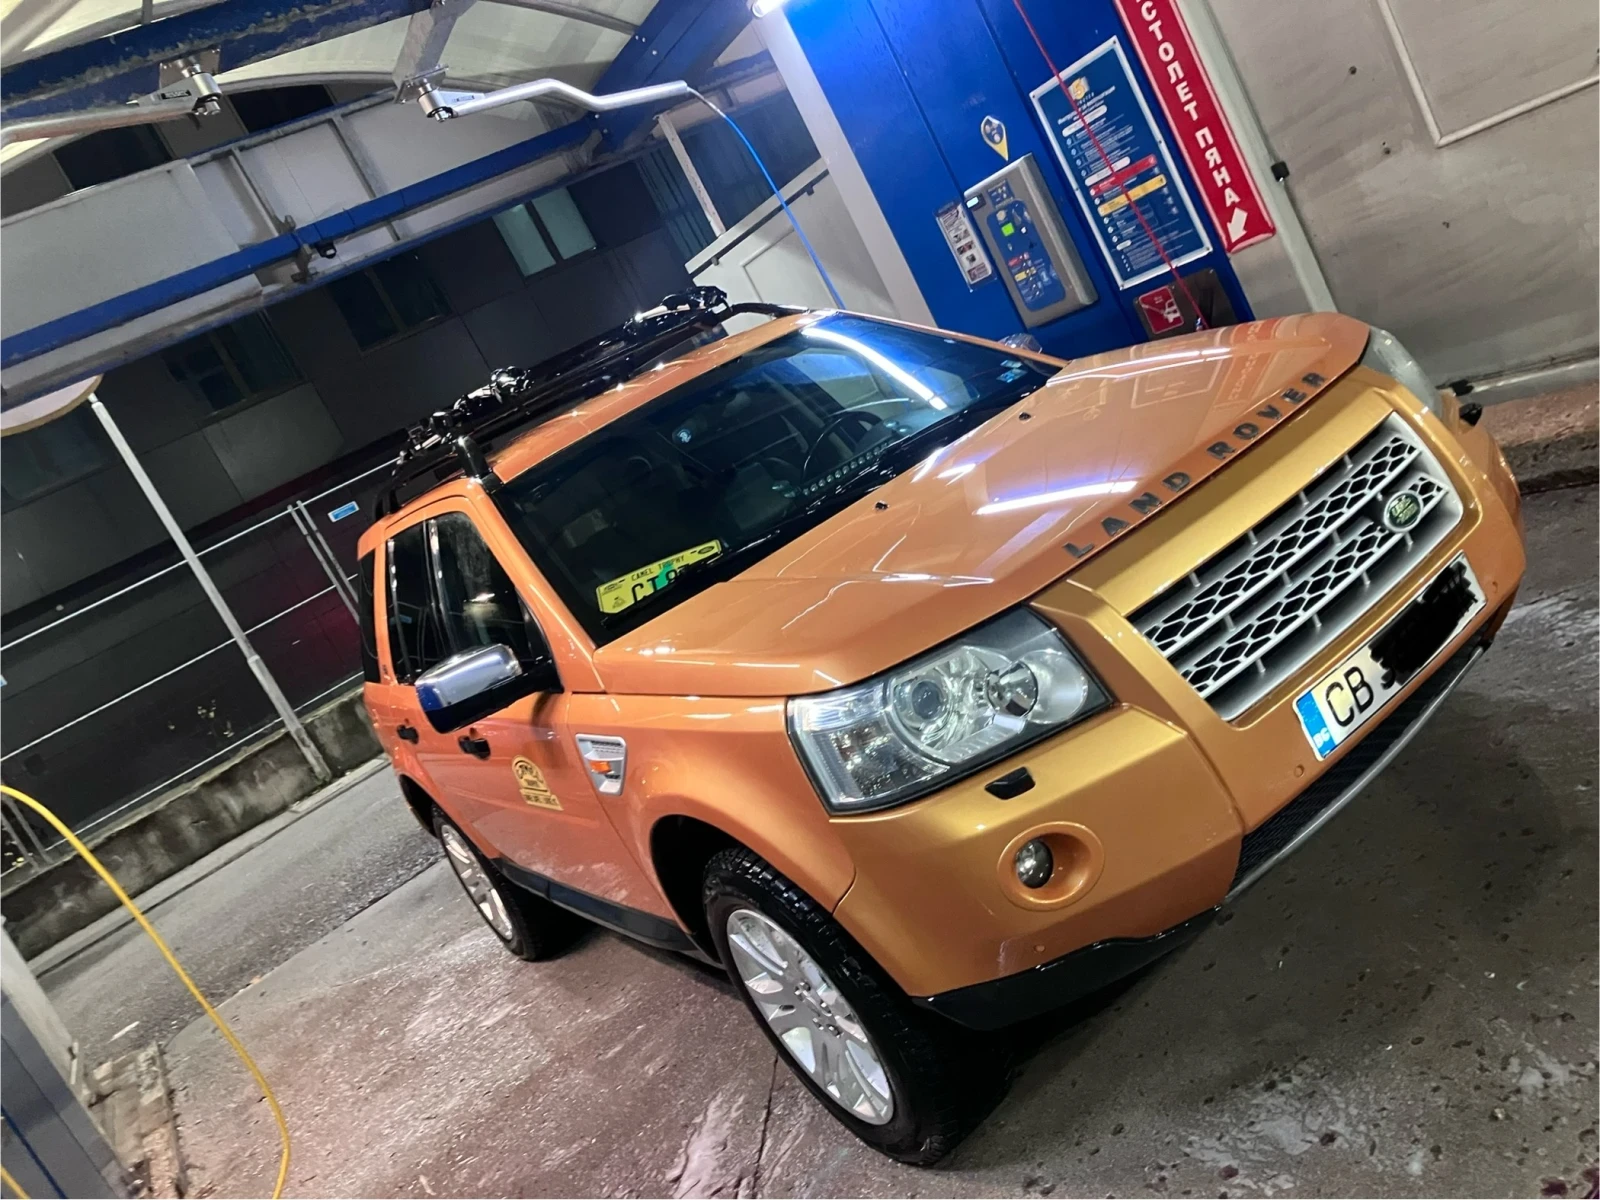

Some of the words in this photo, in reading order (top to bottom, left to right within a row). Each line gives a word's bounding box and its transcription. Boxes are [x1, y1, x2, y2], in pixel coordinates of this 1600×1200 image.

[1136, 0, 1199, 121] СТОЛЕТ
[1195, 126, 1240, 207] ПЯНА
[1062, 471, 1192, 559] LAND
[1206, 372, 1326, 460] ROVER
[631, 566, 654, 582] CAMEL
[1325, 666, 1375, 728] CB
